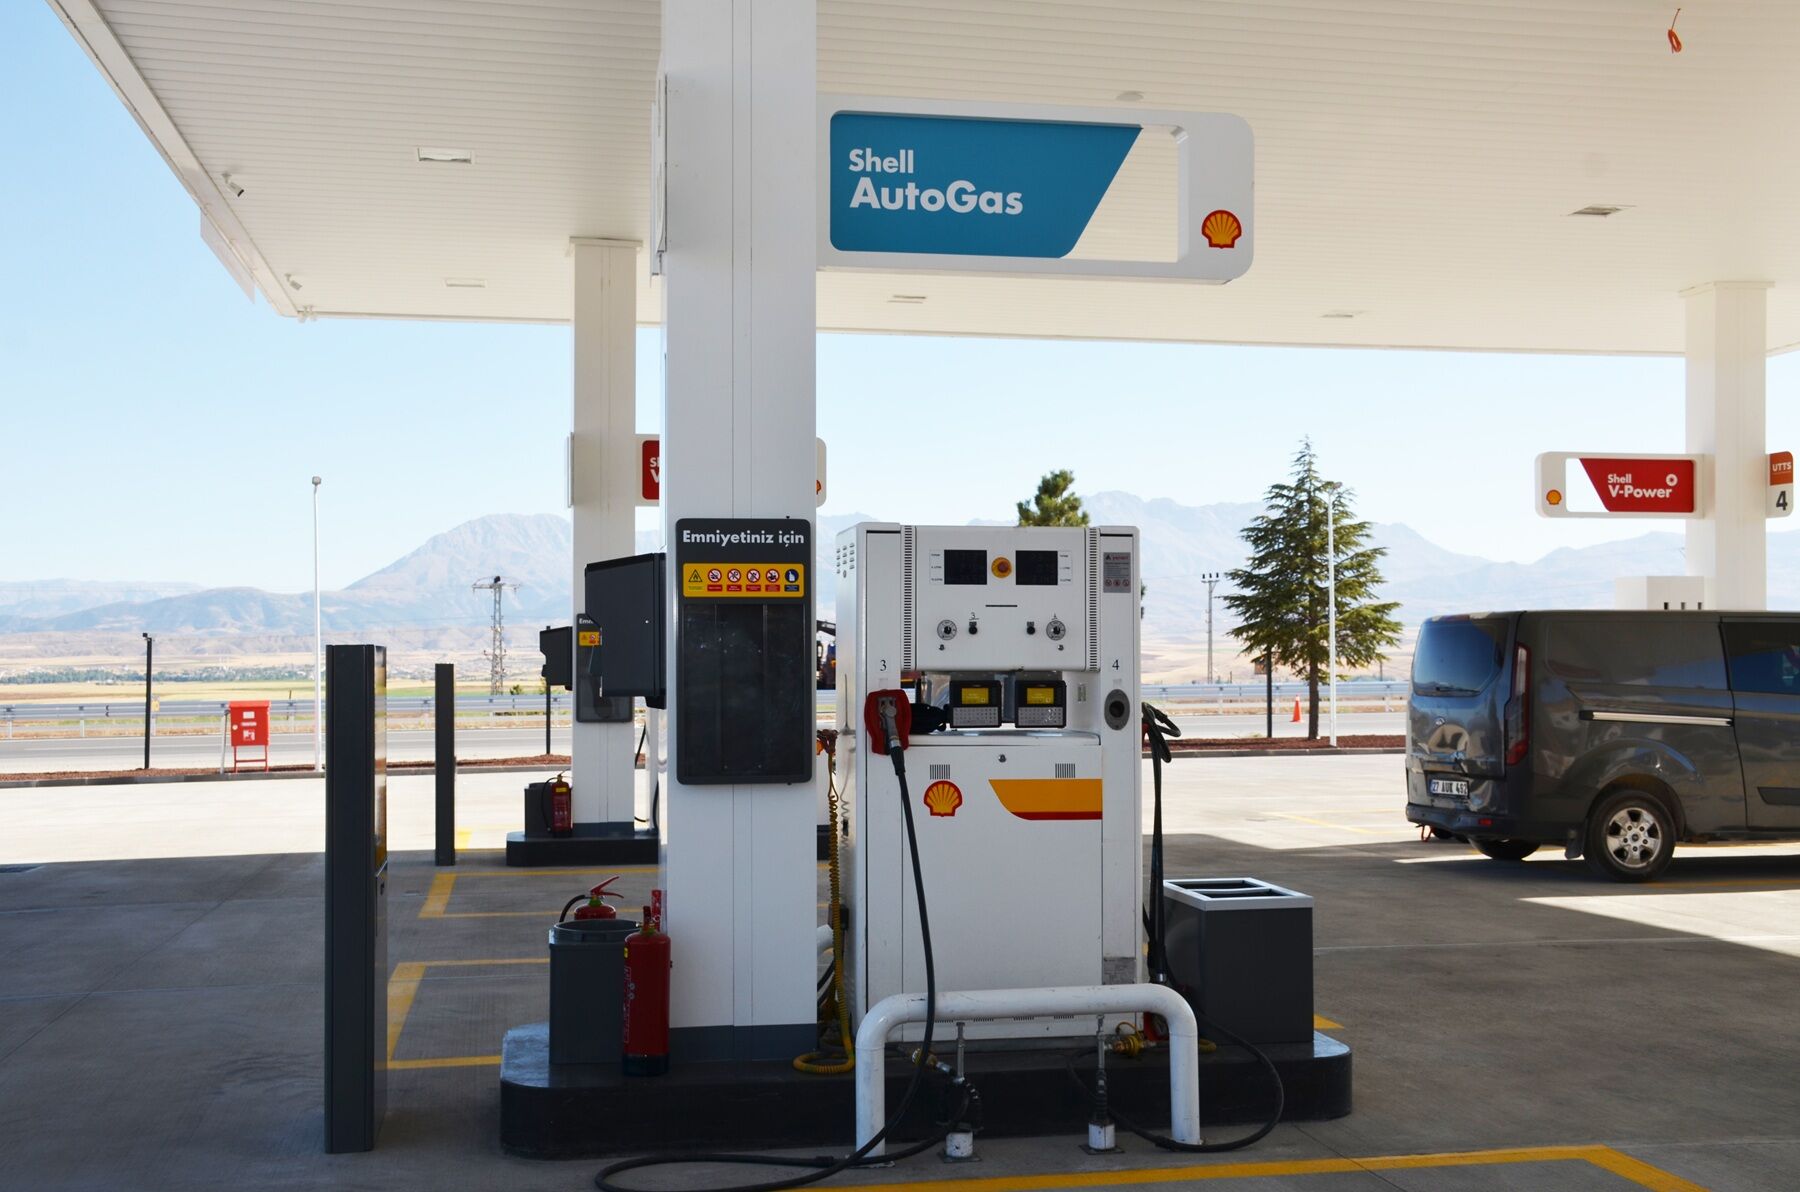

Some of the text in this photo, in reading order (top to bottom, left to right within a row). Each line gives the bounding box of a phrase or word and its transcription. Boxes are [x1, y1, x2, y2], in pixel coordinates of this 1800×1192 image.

[848, 147, 914, 174] Shell
[849, 176, 1024, 215] AutoGas
[1772, 461, 1792, 472] UTTS
[1607, 473, 1632, 484] Shell
[1608, 484, 1672, 498] V-Power
[1775, 490, 1788, 511] 4
[682, 529, 805, 548] Emniyetiniz için
[879, 659, 887, 672] 3
[1111, 658, 1120, 671] 4
